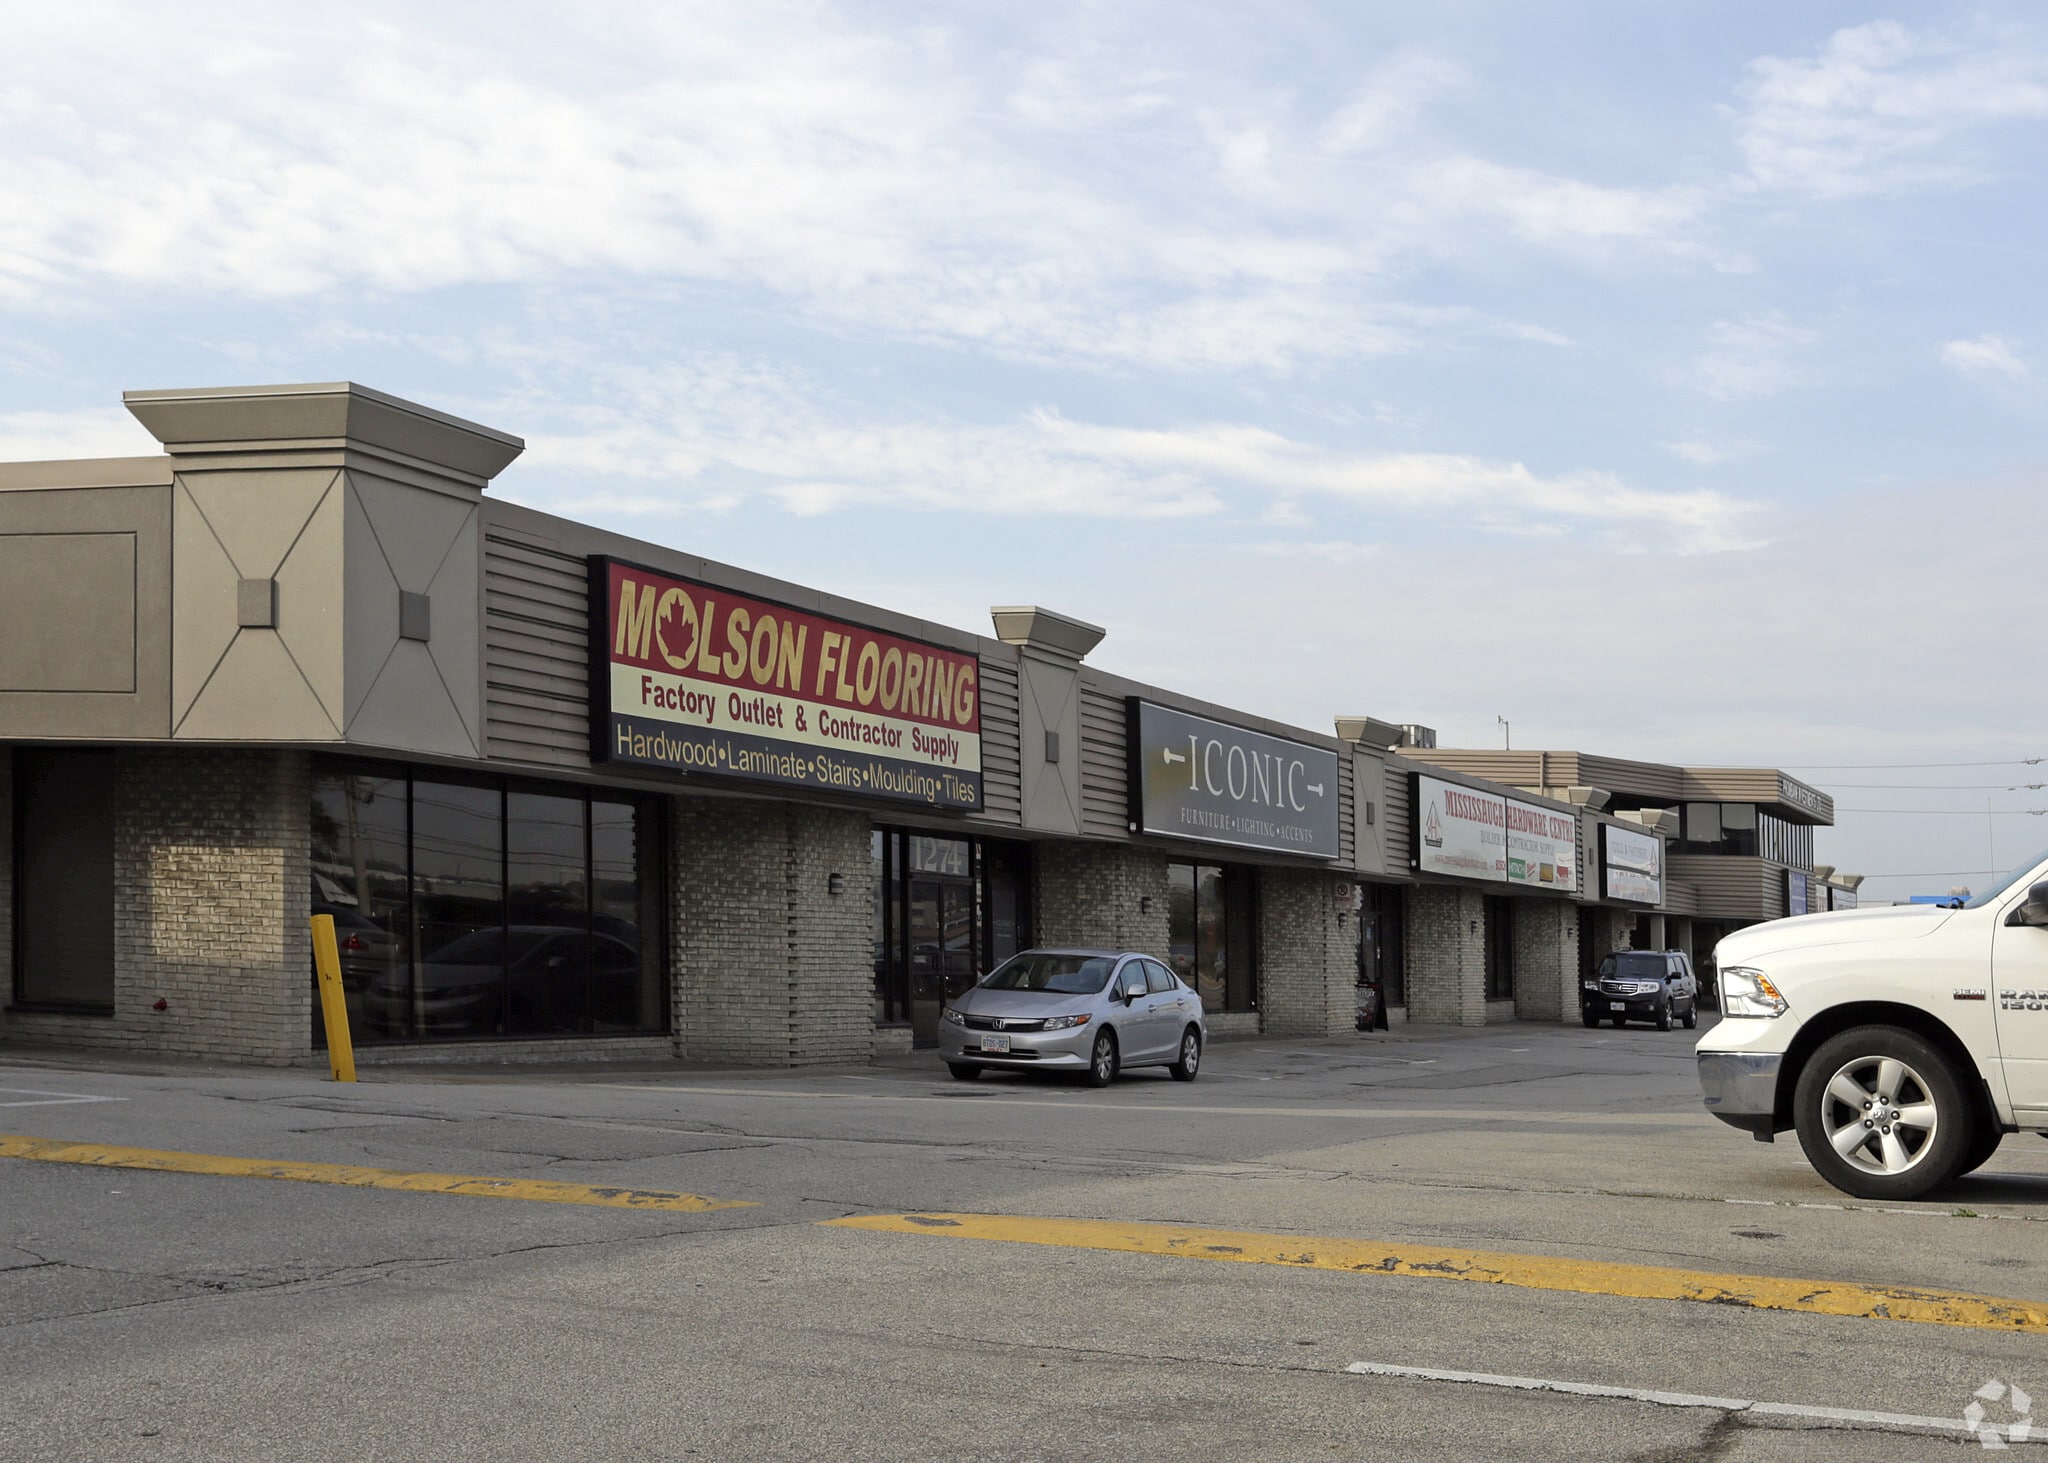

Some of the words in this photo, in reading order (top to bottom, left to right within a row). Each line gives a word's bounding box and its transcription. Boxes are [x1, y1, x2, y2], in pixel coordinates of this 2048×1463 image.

[615, 579, 807, 692] MOLSON
[816, 631, 975, 725] FLOORING
[641, 675, 715, 724] Factory
[728, 692, 783, 729] Outlet
[795, 705, 807, 732] &
[818, 712, 902, 749] Contractor
[912, 731, 959, 764] Supply
[617, 723, 717, 768] Hardwood
[727, 741, 806, 780] Laminate
[816, 755, 861, 788] Stairs
[870, 763, 936, 803] Moulding
[942, 774, 975, 803] Tiles
[1188, 734, 1306, 812] ICONIC
[1181, 807, 1230, 831] FURNITURE
[1236, 817, 1275, 838] LIGHTING
[1281, 826, 1313, 843] ACCENTS
[1444, 789, 1504, 828] MISSISSAUGA
[1507, 805, 1548, 837] HARDWARE
[1550, 816, 1574, 843] CENTRE
[915, 837, 962, 874] 1274
